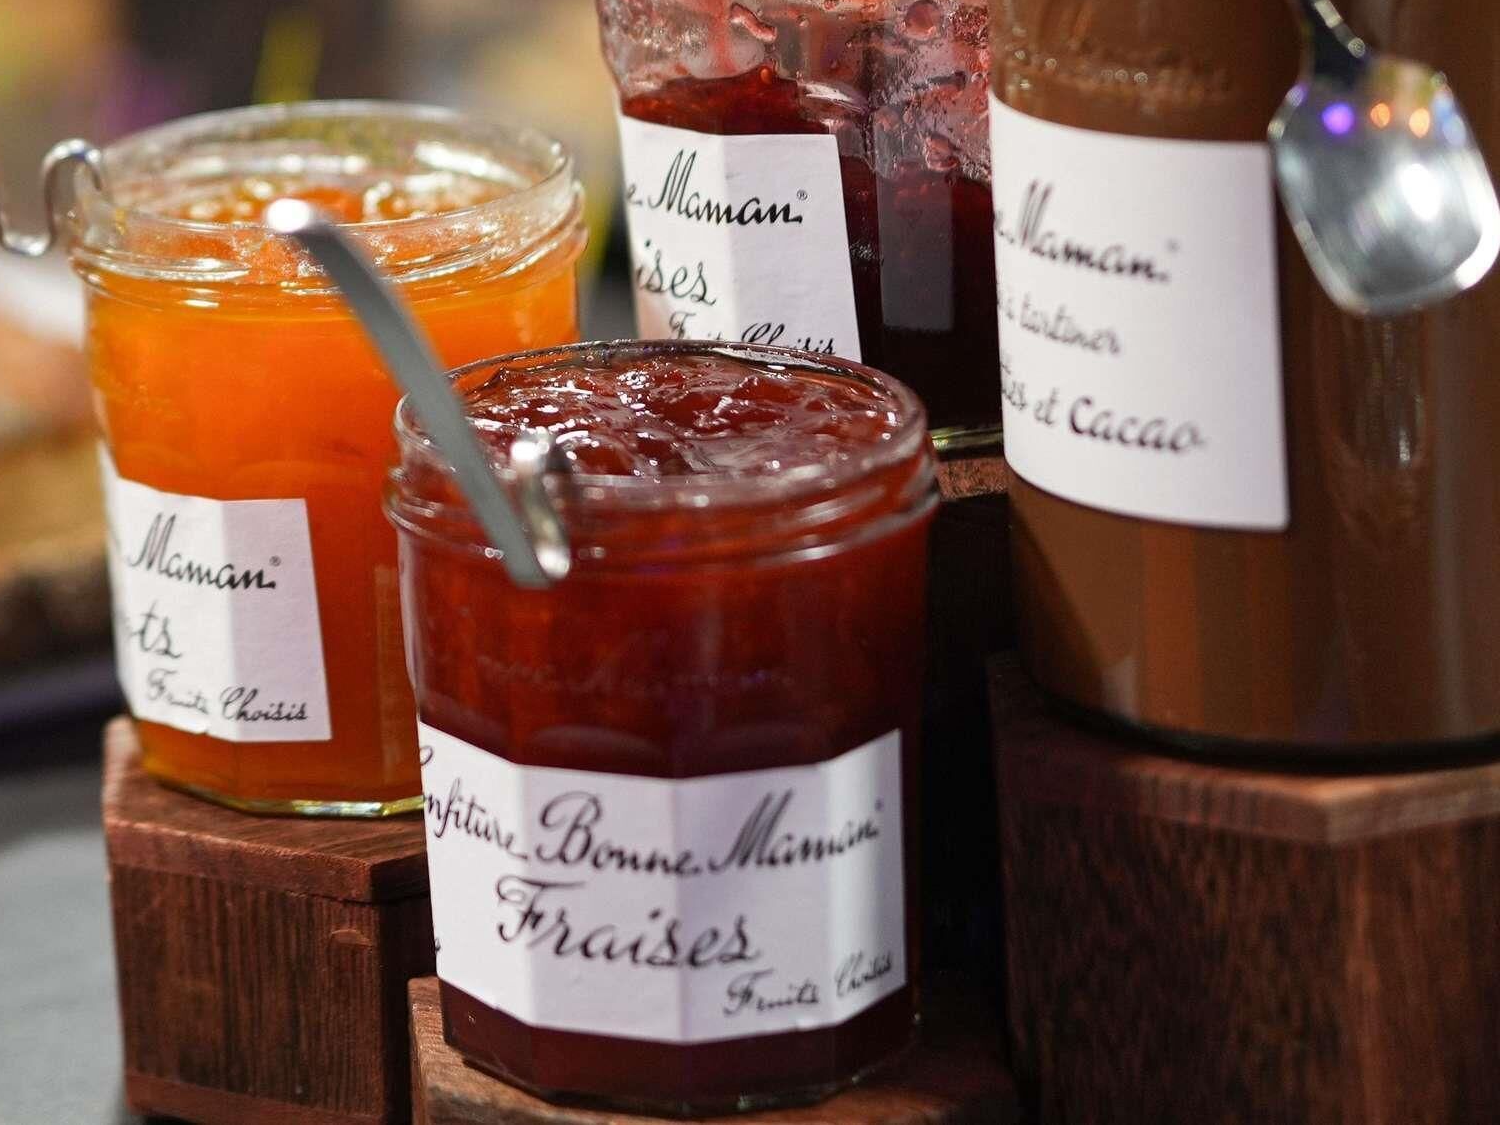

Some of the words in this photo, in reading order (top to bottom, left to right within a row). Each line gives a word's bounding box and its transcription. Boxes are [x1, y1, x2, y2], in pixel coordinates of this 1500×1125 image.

[1033, 387, 1058, 426] et
[1068, 396, 1204, 455] Cacao
[219, 685, 309, 722] Choisis
[535, 790, 704, 876] Bonne
[495, 875, 762, 968] Fraises
[723, 967, 820, 1015] Fruits
